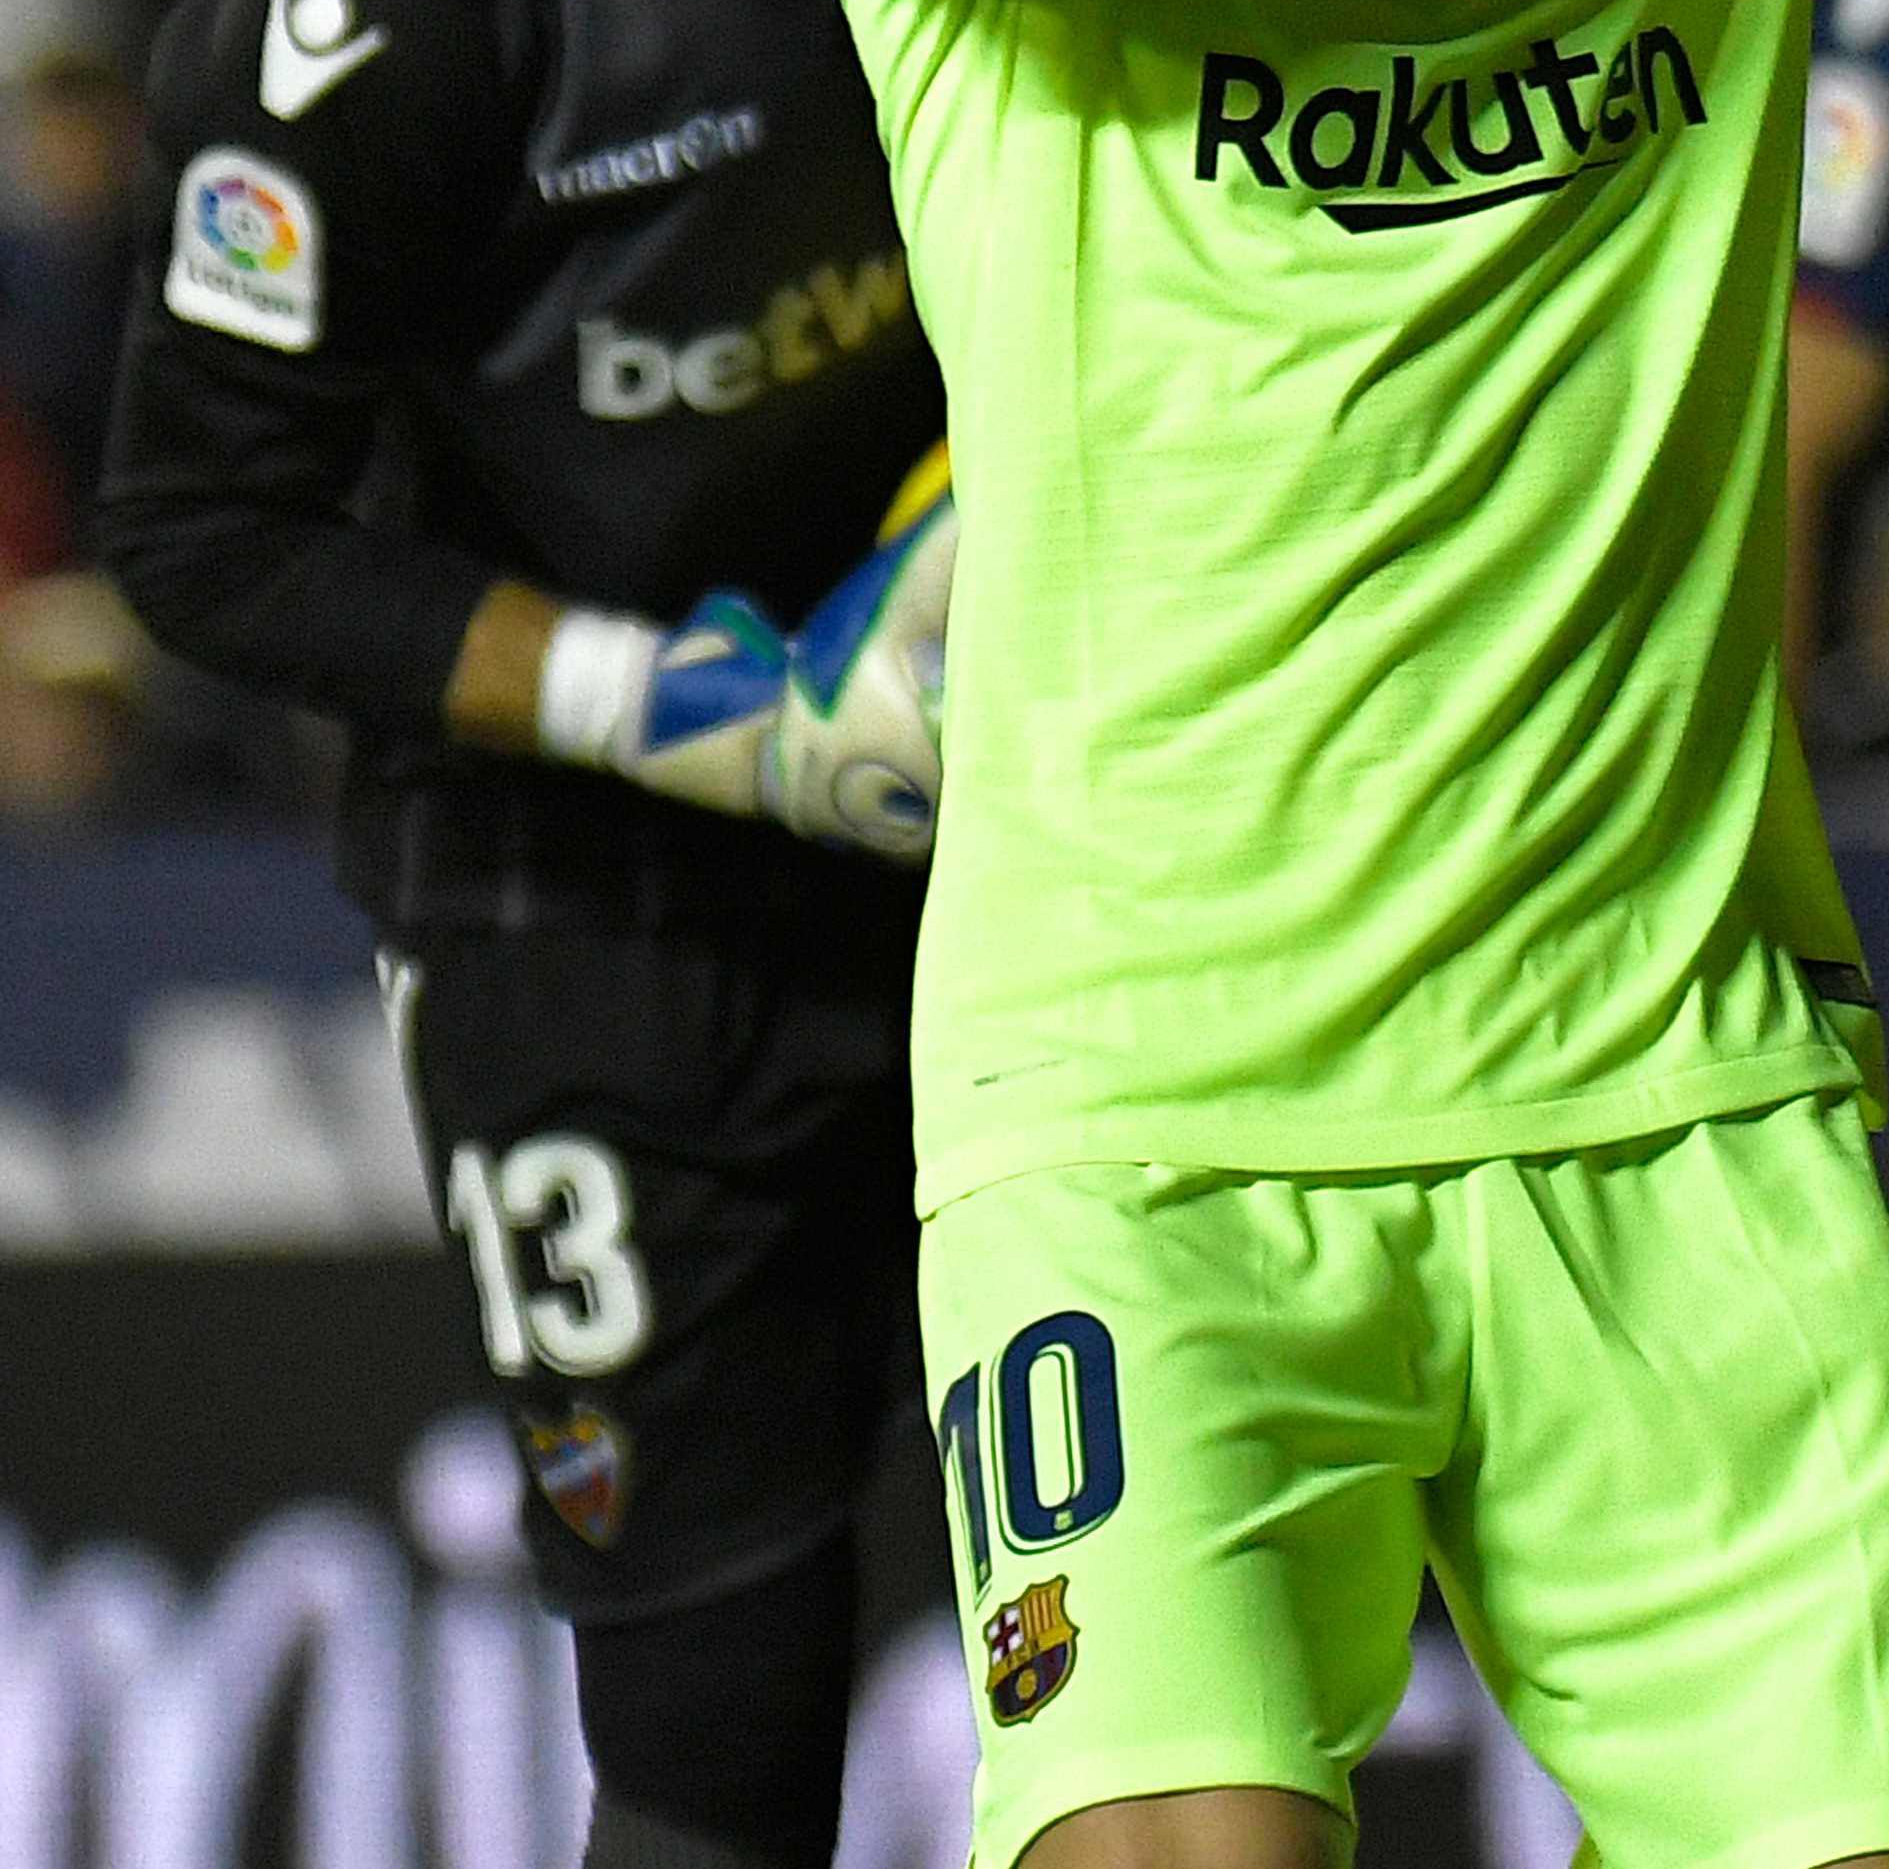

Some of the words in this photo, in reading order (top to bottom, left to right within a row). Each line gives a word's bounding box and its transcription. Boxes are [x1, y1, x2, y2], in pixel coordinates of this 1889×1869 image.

[1194, 23, 1709, 191] Rakuten
[575, 249, 908, 423] betw
[446, 1131, 653, 1379] 13
[937, 1309, 1124, 1603] 10
